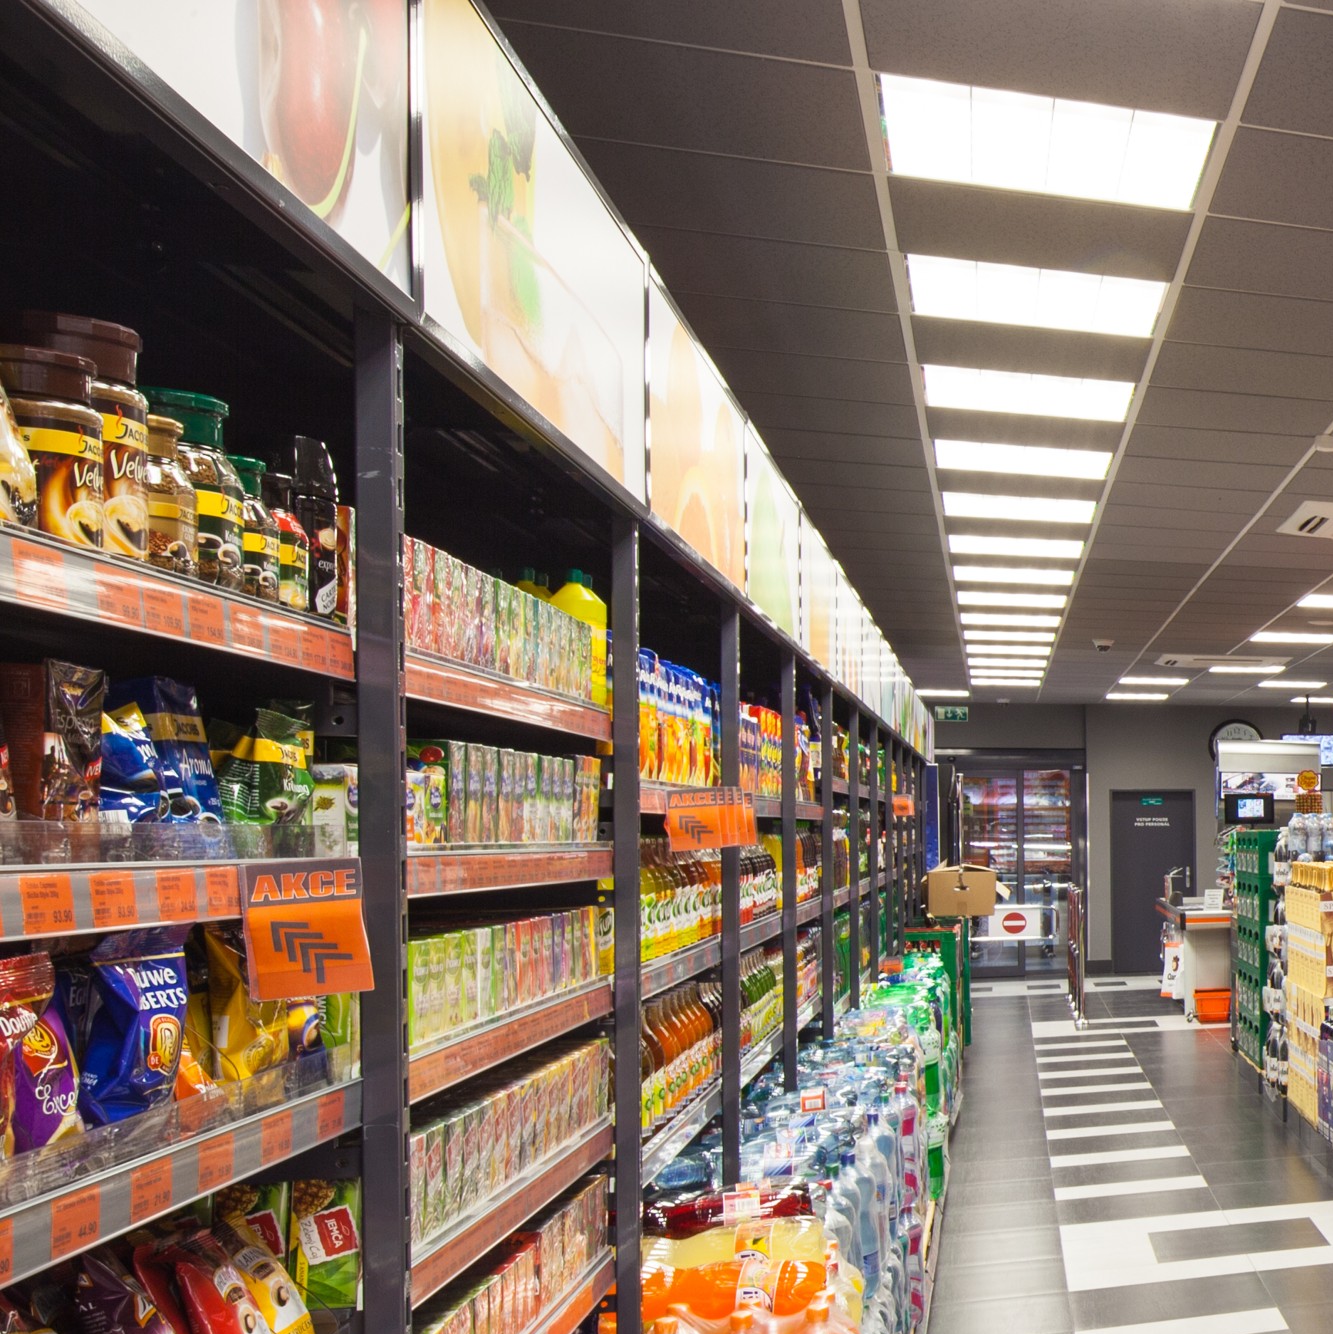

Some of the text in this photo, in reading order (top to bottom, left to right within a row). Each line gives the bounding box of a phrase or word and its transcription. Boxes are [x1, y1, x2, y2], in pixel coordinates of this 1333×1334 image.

[178, 747, 213, 782] Aroma
[669, 790, 717, 808] AKCE
[251, 868, 357, 904] AKCE
[325, 1218, 344, 1249] JEMČA
